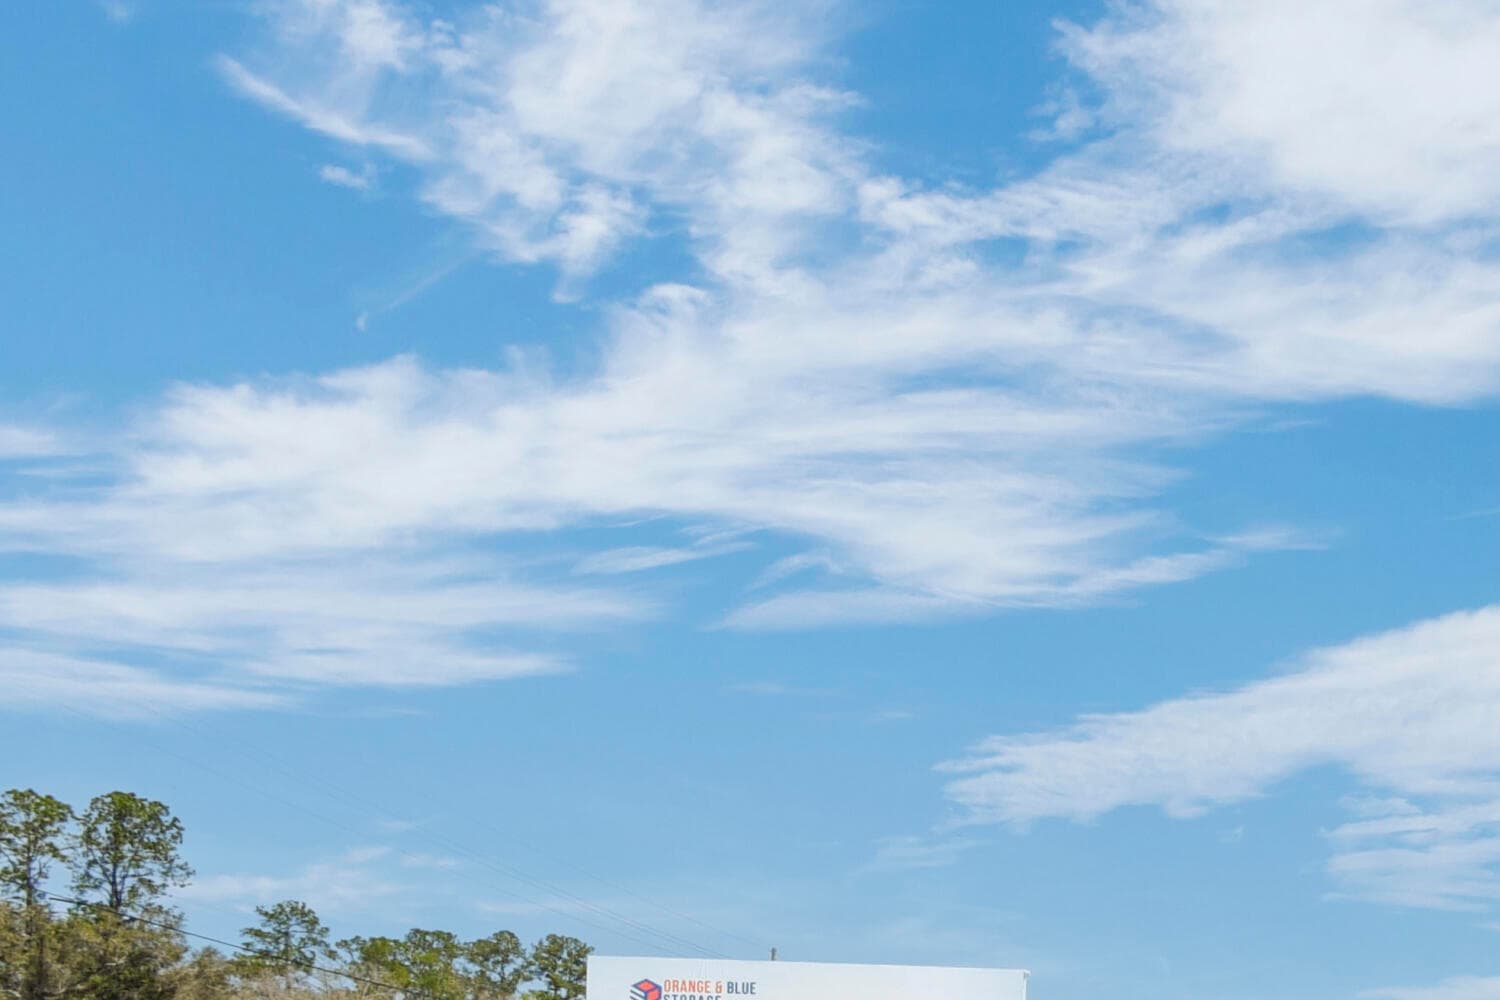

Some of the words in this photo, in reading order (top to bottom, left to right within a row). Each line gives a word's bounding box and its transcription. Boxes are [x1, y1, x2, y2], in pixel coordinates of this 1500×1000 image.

[663, 979, 711, 993] ORANGE
[715, 981, 723, 993] &
[727, 981, 756, 995] BLUE
